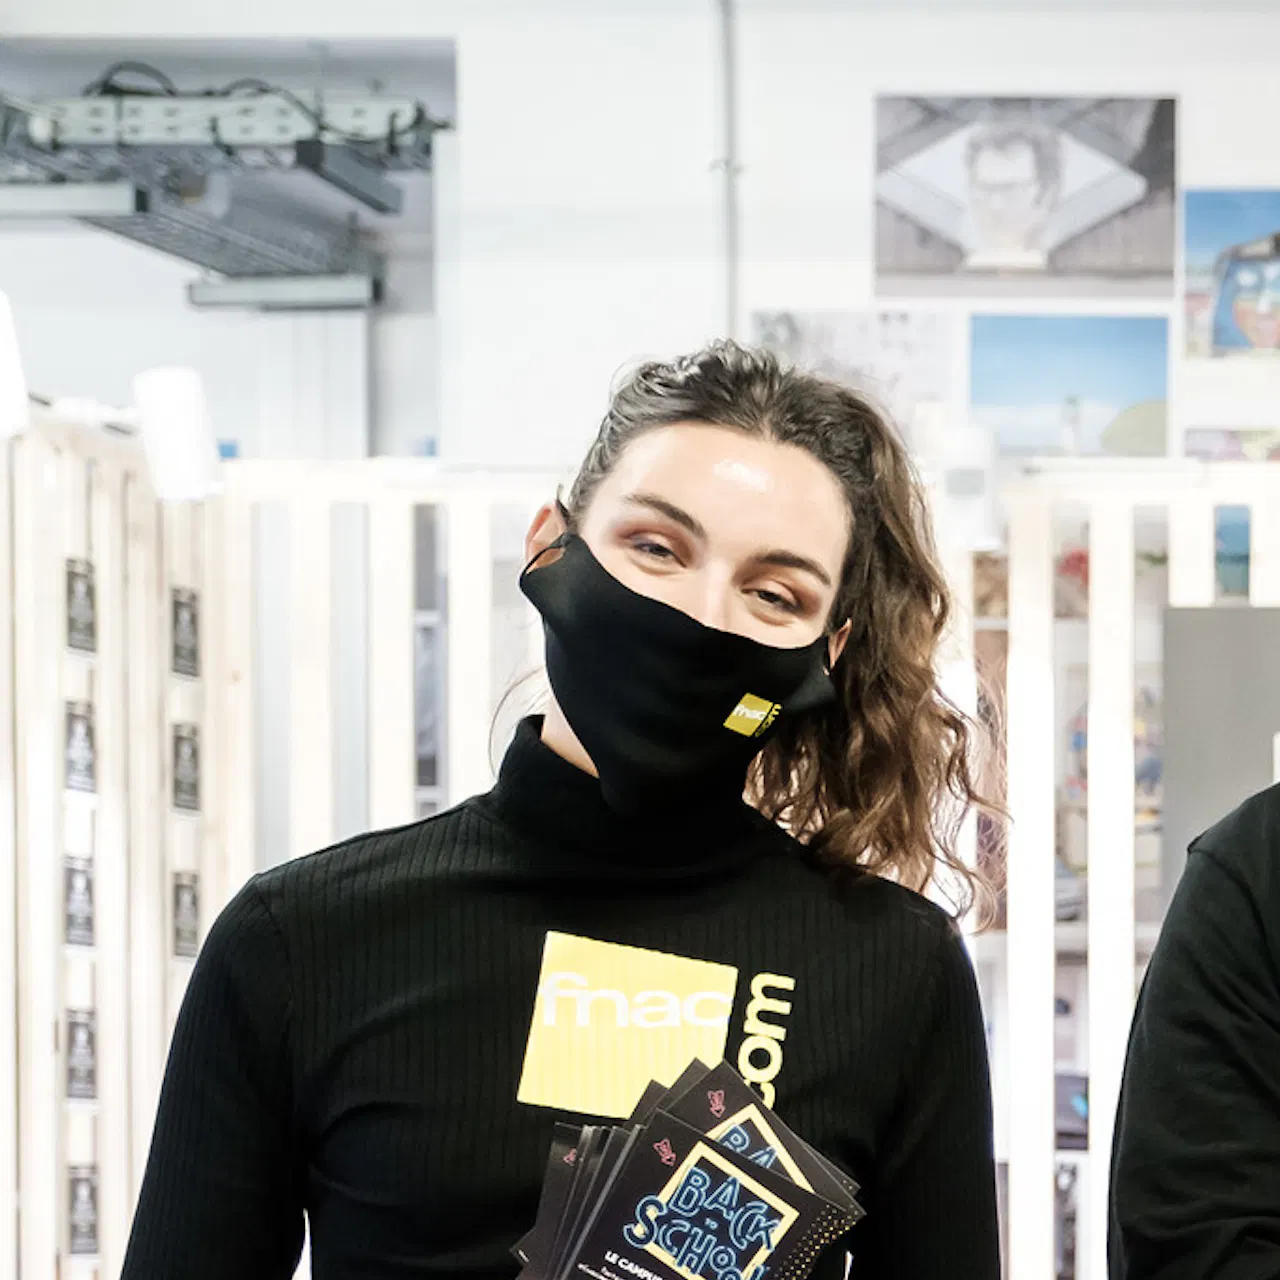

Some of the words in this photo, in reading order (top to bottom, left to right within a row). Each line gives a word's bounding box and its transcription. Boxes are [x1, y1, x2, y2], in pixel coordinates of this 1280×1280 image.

[539, 971, 734, 1028] fnac
[669, 1166, 781, 1251] BACK
[604, 1251, 617, 1267] LE
